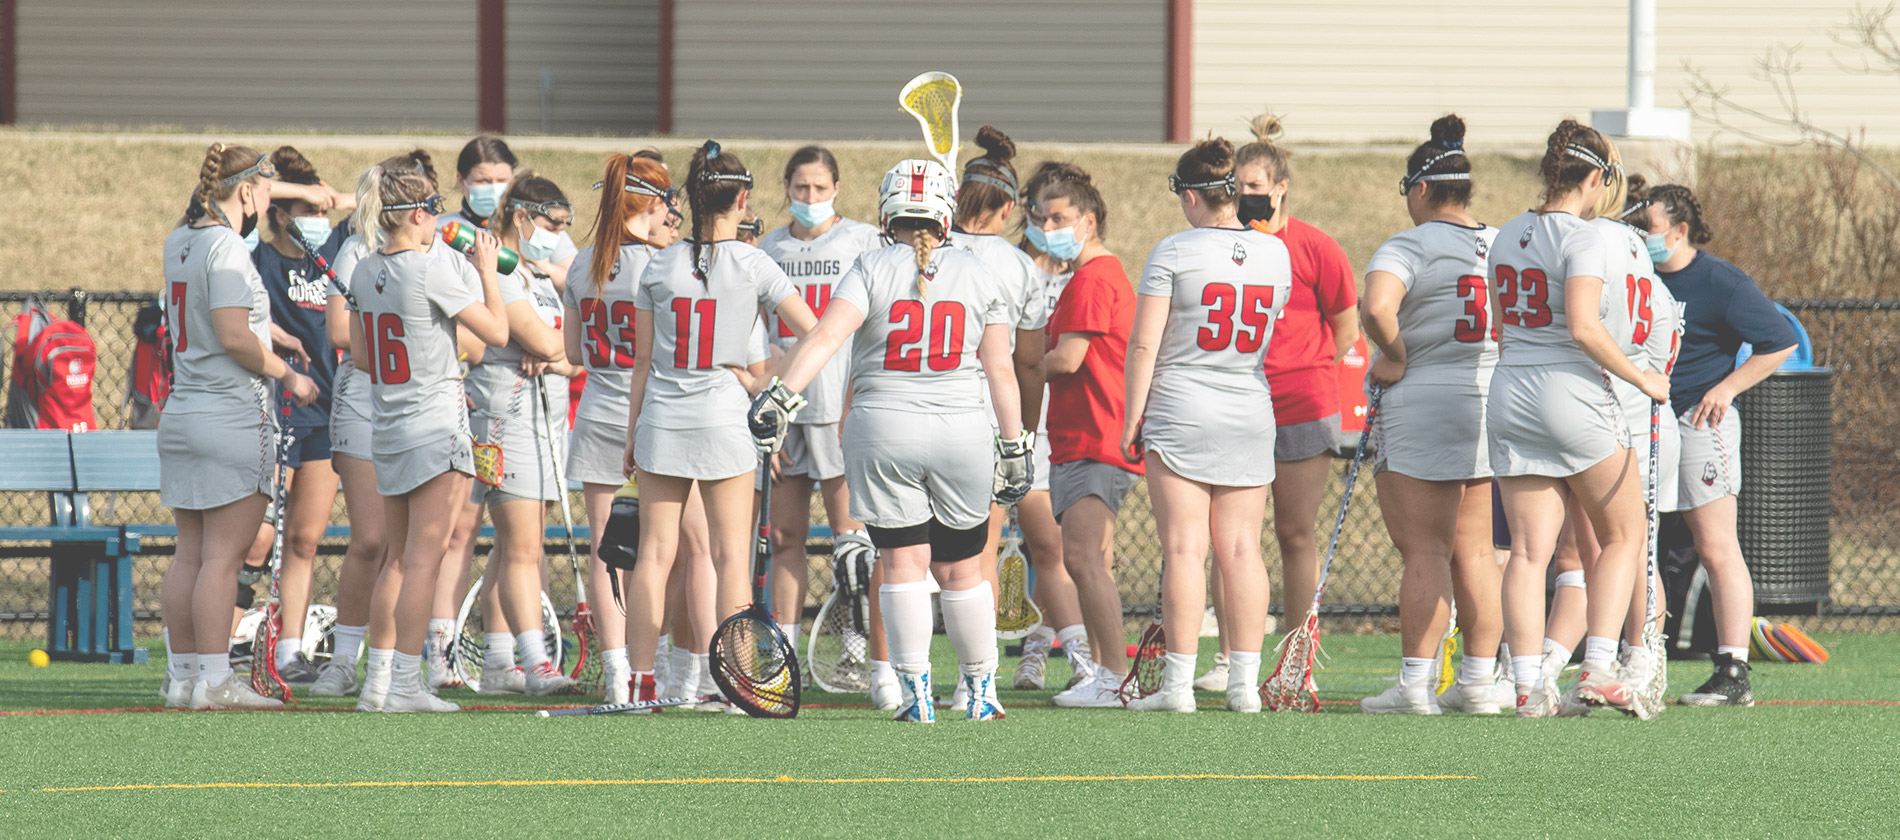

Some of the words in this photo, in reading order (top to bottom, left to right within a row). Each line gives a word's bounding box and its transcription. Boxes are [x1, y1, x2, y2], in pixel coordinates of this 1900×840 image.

[777, 260, 841, 277] ULLDOGS
[1495, 264, 1553, 328] 23
[171, 282, 188, 352] 7
[580, 297, 636, 368] 33
[671, 297, 717, 370] 11
[883, 299, 966, 372] 20
[1196, 282, 1274, 354] 35
[1454, 274, 1498, 343] 3
[1626, 274, 1652, 345] 19
[362, 311, 411, 385] 16
